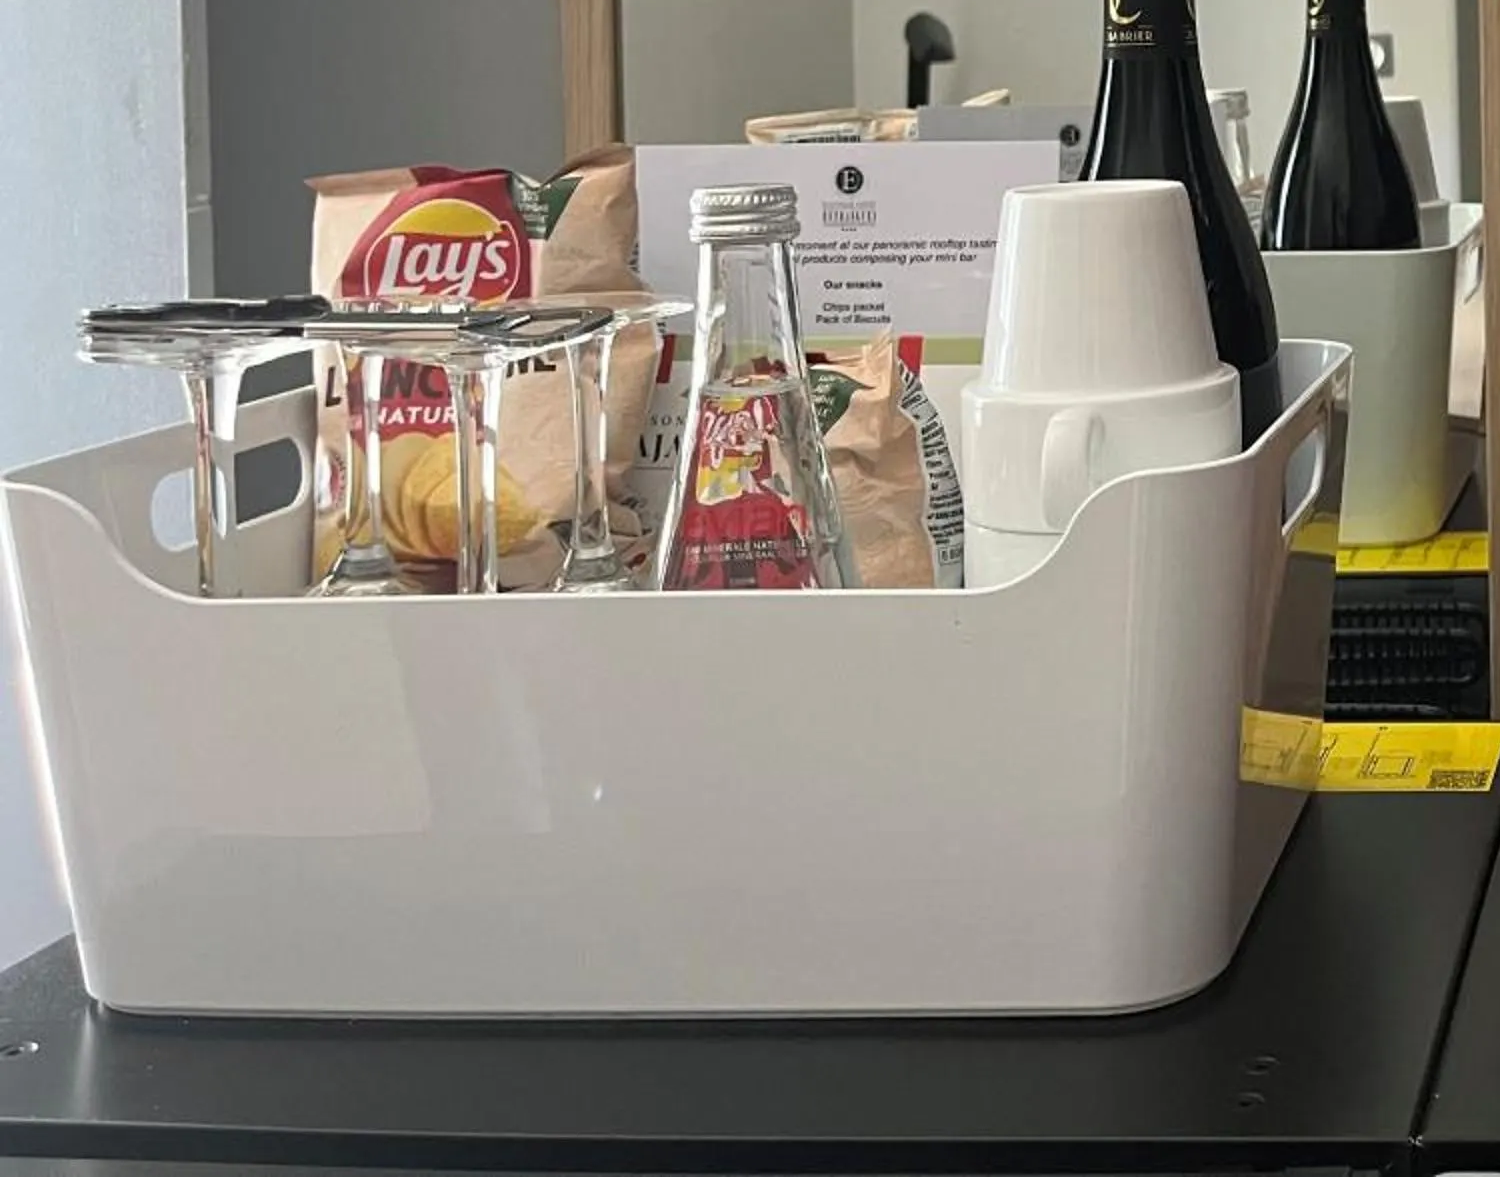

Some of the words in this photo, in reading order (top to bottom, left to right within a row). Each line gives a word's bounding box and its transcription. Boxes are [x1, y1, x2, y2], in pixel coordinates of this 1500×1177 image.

[795, 240, 837, 250] moment
[853, 241, 869, 250] our
[872, 239, 926, 252] panoramic
[929, 238, 967, 251] rooftop
[969, 238, 998, 249] tastin
[376, 230, 511, 298] Lay's
[801, 254, 847, 266] products
[849, 253, 906, 266] composing
[909, 254, 932, 265] your
[959, 252, 977, 262] bar
[823, 280, 843, 290] Our
[845, 280, 883, 290] snacks
[823, 302, 850, 314] Chips
[853, 302, 885, 314] packet
[816, 314, 840, 324] Pack
[842, 314, 852, 324] of
[854, 314, 891, 324] Biscuits
[376, 405, 458, 425] NATUR
